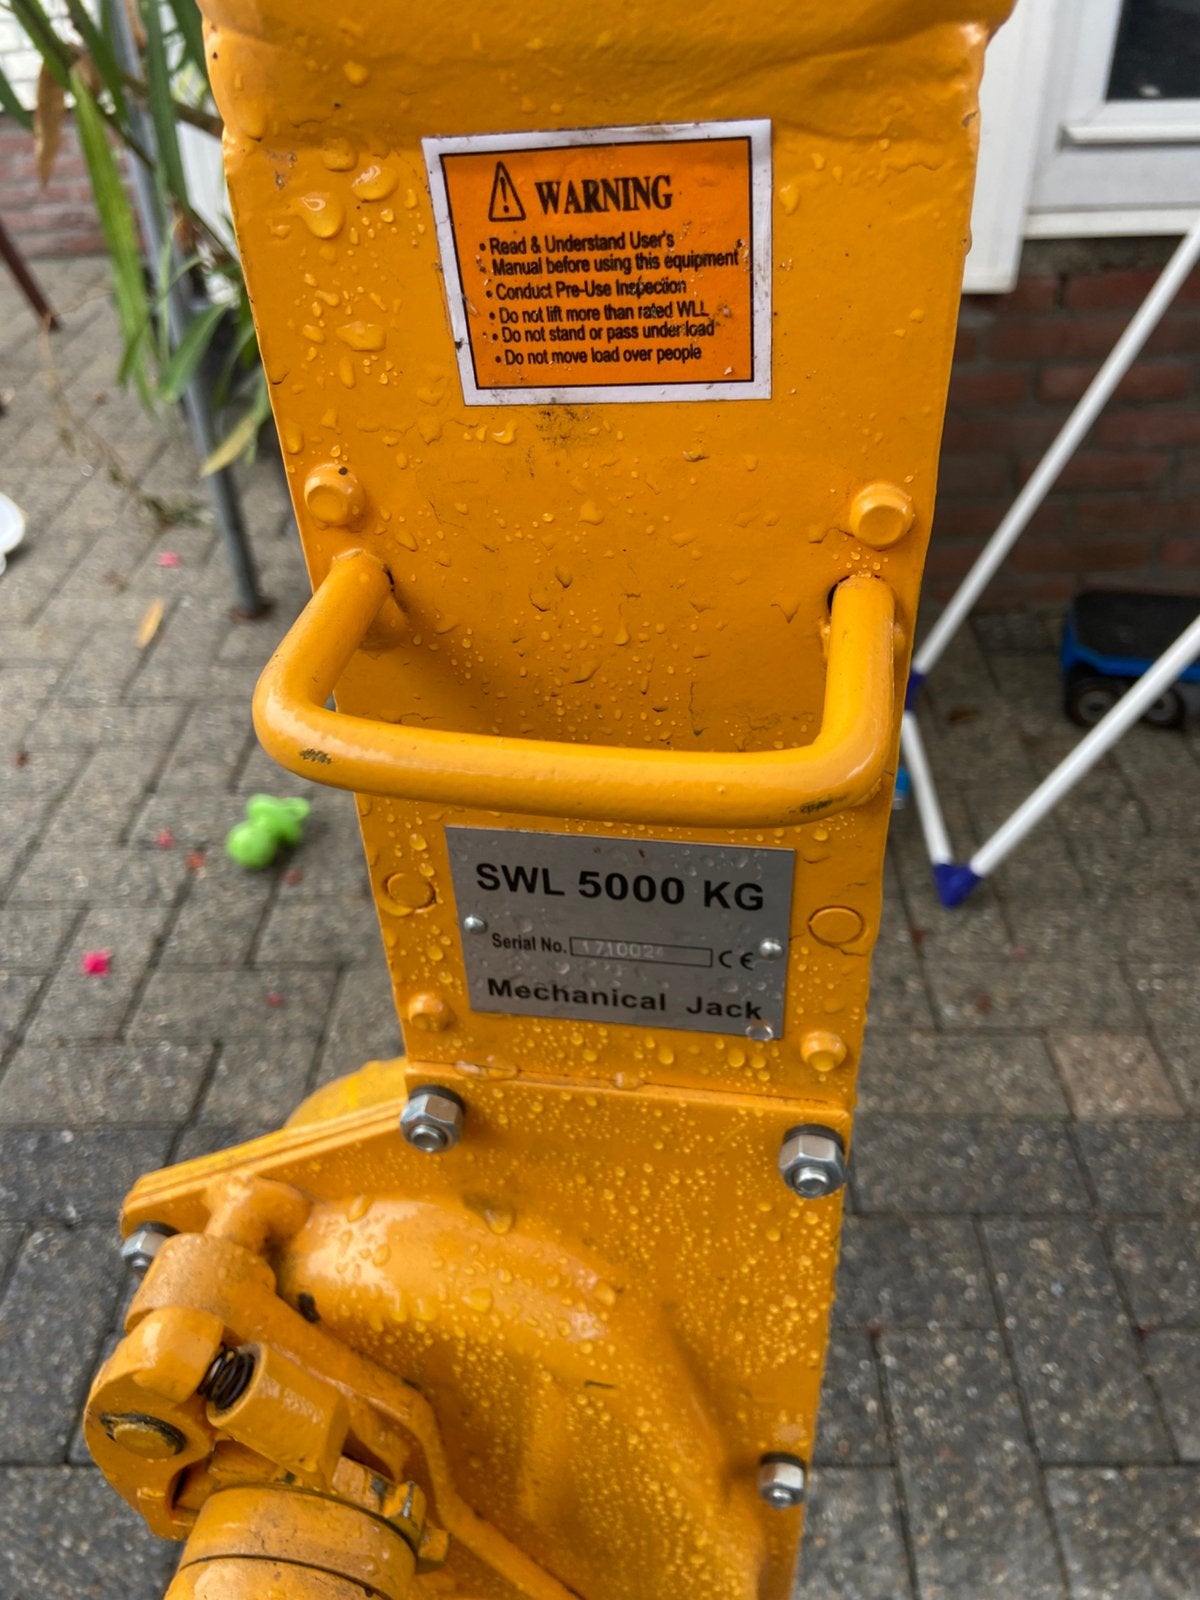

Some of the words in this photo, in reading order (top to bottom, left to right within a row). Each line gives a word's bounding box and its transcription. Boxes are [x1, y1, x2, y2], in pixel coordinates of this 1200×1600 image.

[535, 175, 673, 215] WARNING
[489, 236, 527, 255] Read
[531, 235, 541, 254] &
[544, 231, 626, 253] Understand
[629, 230, 675, 250] User's
[492, 256, 542, 276] Manual
[546, 254, 591, 275] before
[594, 253, 632, 275] using
[635, 251, 661, 271] this
[664, 249, 739, 273] equipment
[495, 281, 553, 301] Conduct
[555, 279, 612, 299] Pre-Use
[615, 276, 687, 299] Inspection
[499, 306, 519, 325] Do
[522, 306, 544, 324] not
[546, 304, 563, 323] lift
[566, 306, 601, 322] more
[604, 303, 634, 321] than
[638, 300, 673, 319] rated
[676, 299, 710, 318] WLL
[501, 325, 522, 344] Do
[525, 325, 546, 342] not
[549, 323, 586, 342] stand
[589, 326, 603, 341] or
[606, 324, 639, 344] pass
[642, 320, 682, 339] under
[685, 319, 715, 338] load
[504, 348, 524, 366] Do
[527, 348, 549, 365] not
[551, 350, 588, 364] move
[591, 345, 620, 364] load
[622, 347, 653, 362] over
[656, 342, 702, 364] people
[475, 862, 565, 897] SWL
[577, 870, 686, 905] 5000
[702, 880, 765, 912] KG
[492, 933, 537, 951] Serial
[540, 938, 567, 954] No.
[487, 977, 667, 1012] Mechanical
[686, 997, 763, 1020] Jack
